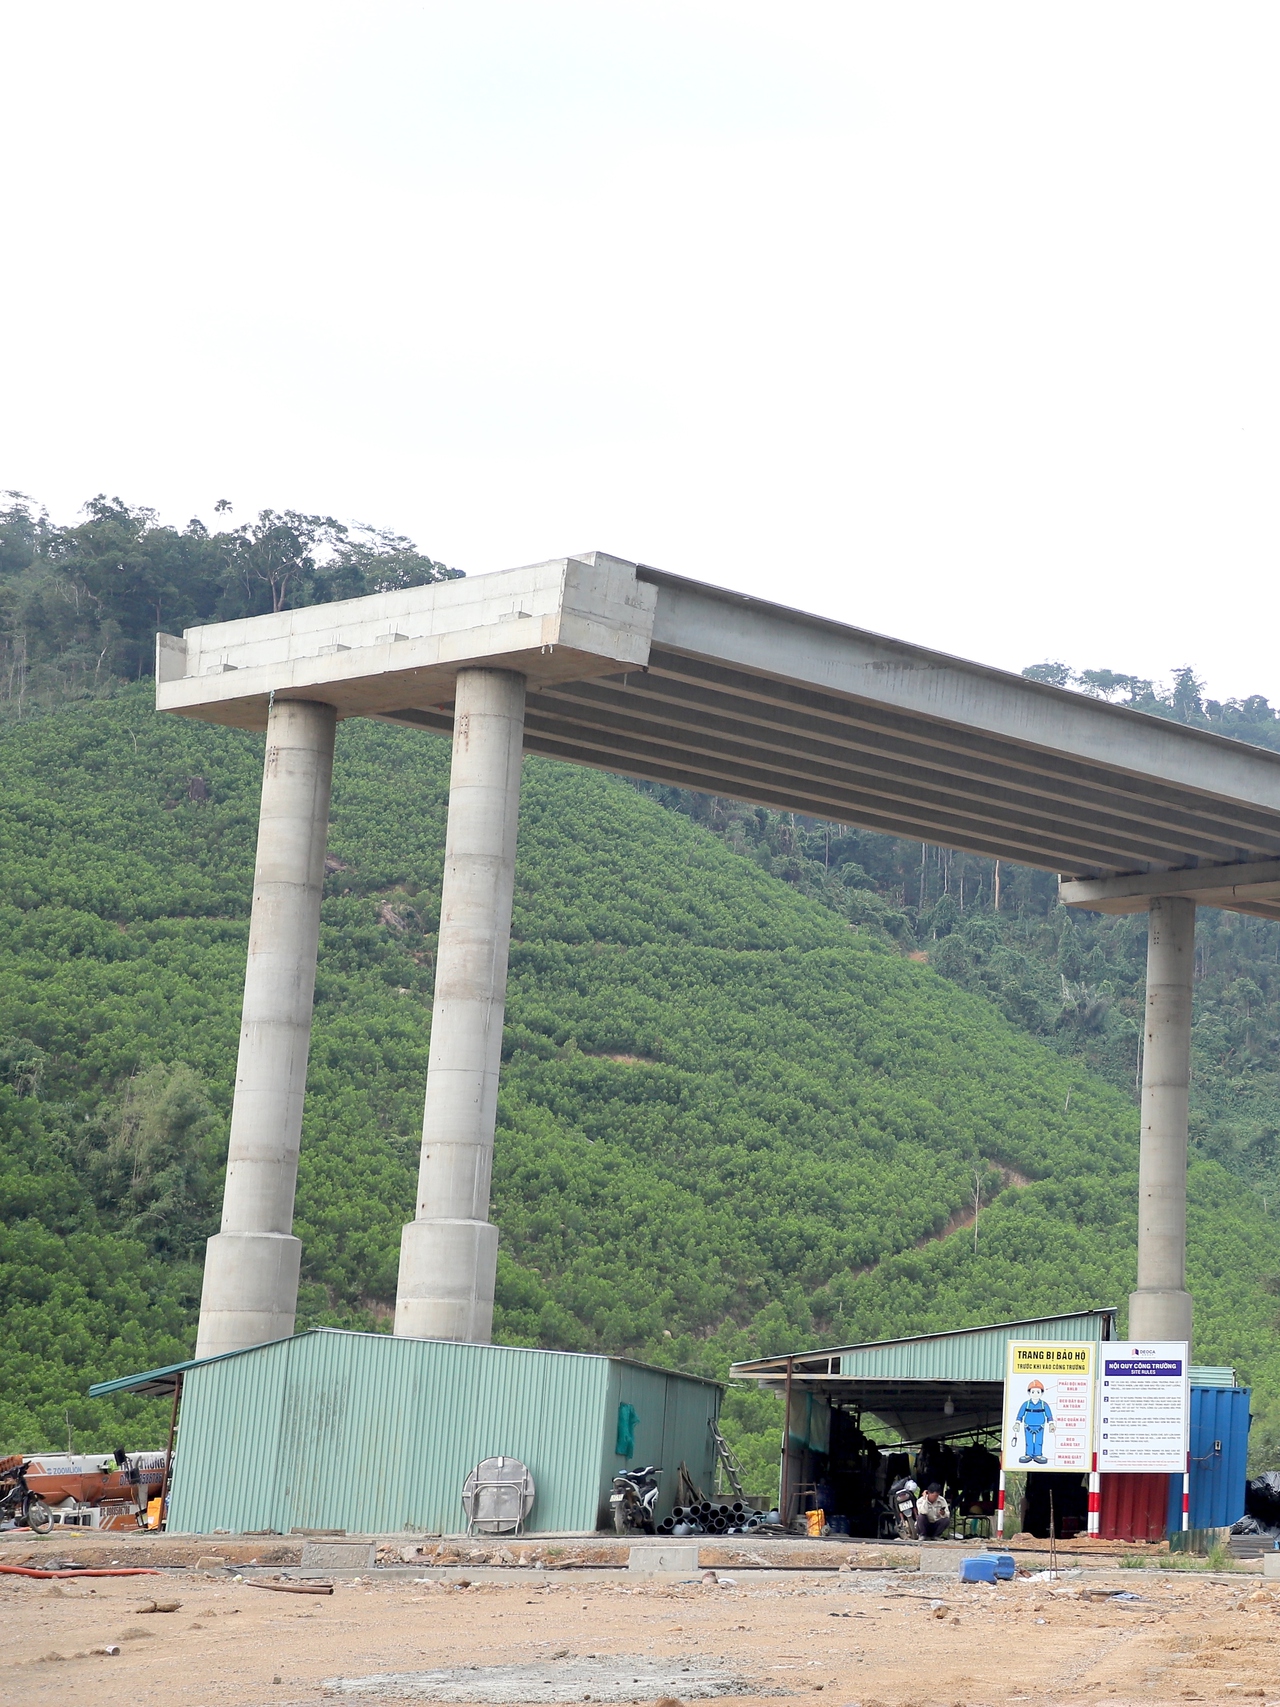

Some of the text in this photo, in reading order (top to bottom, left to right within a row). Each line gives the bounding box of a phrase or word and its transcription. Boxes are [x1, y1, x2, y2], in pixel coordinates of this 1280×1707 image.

[1018, 1349, 1086, 1362] TRANG BỊ BẢO HỘ
[1066, 1363, 1085, 1371] TRƯỜNG
[1109, 1362, 1119, 1370] NỘI
[53, 1466, 82, 1474] ZOOMLION
